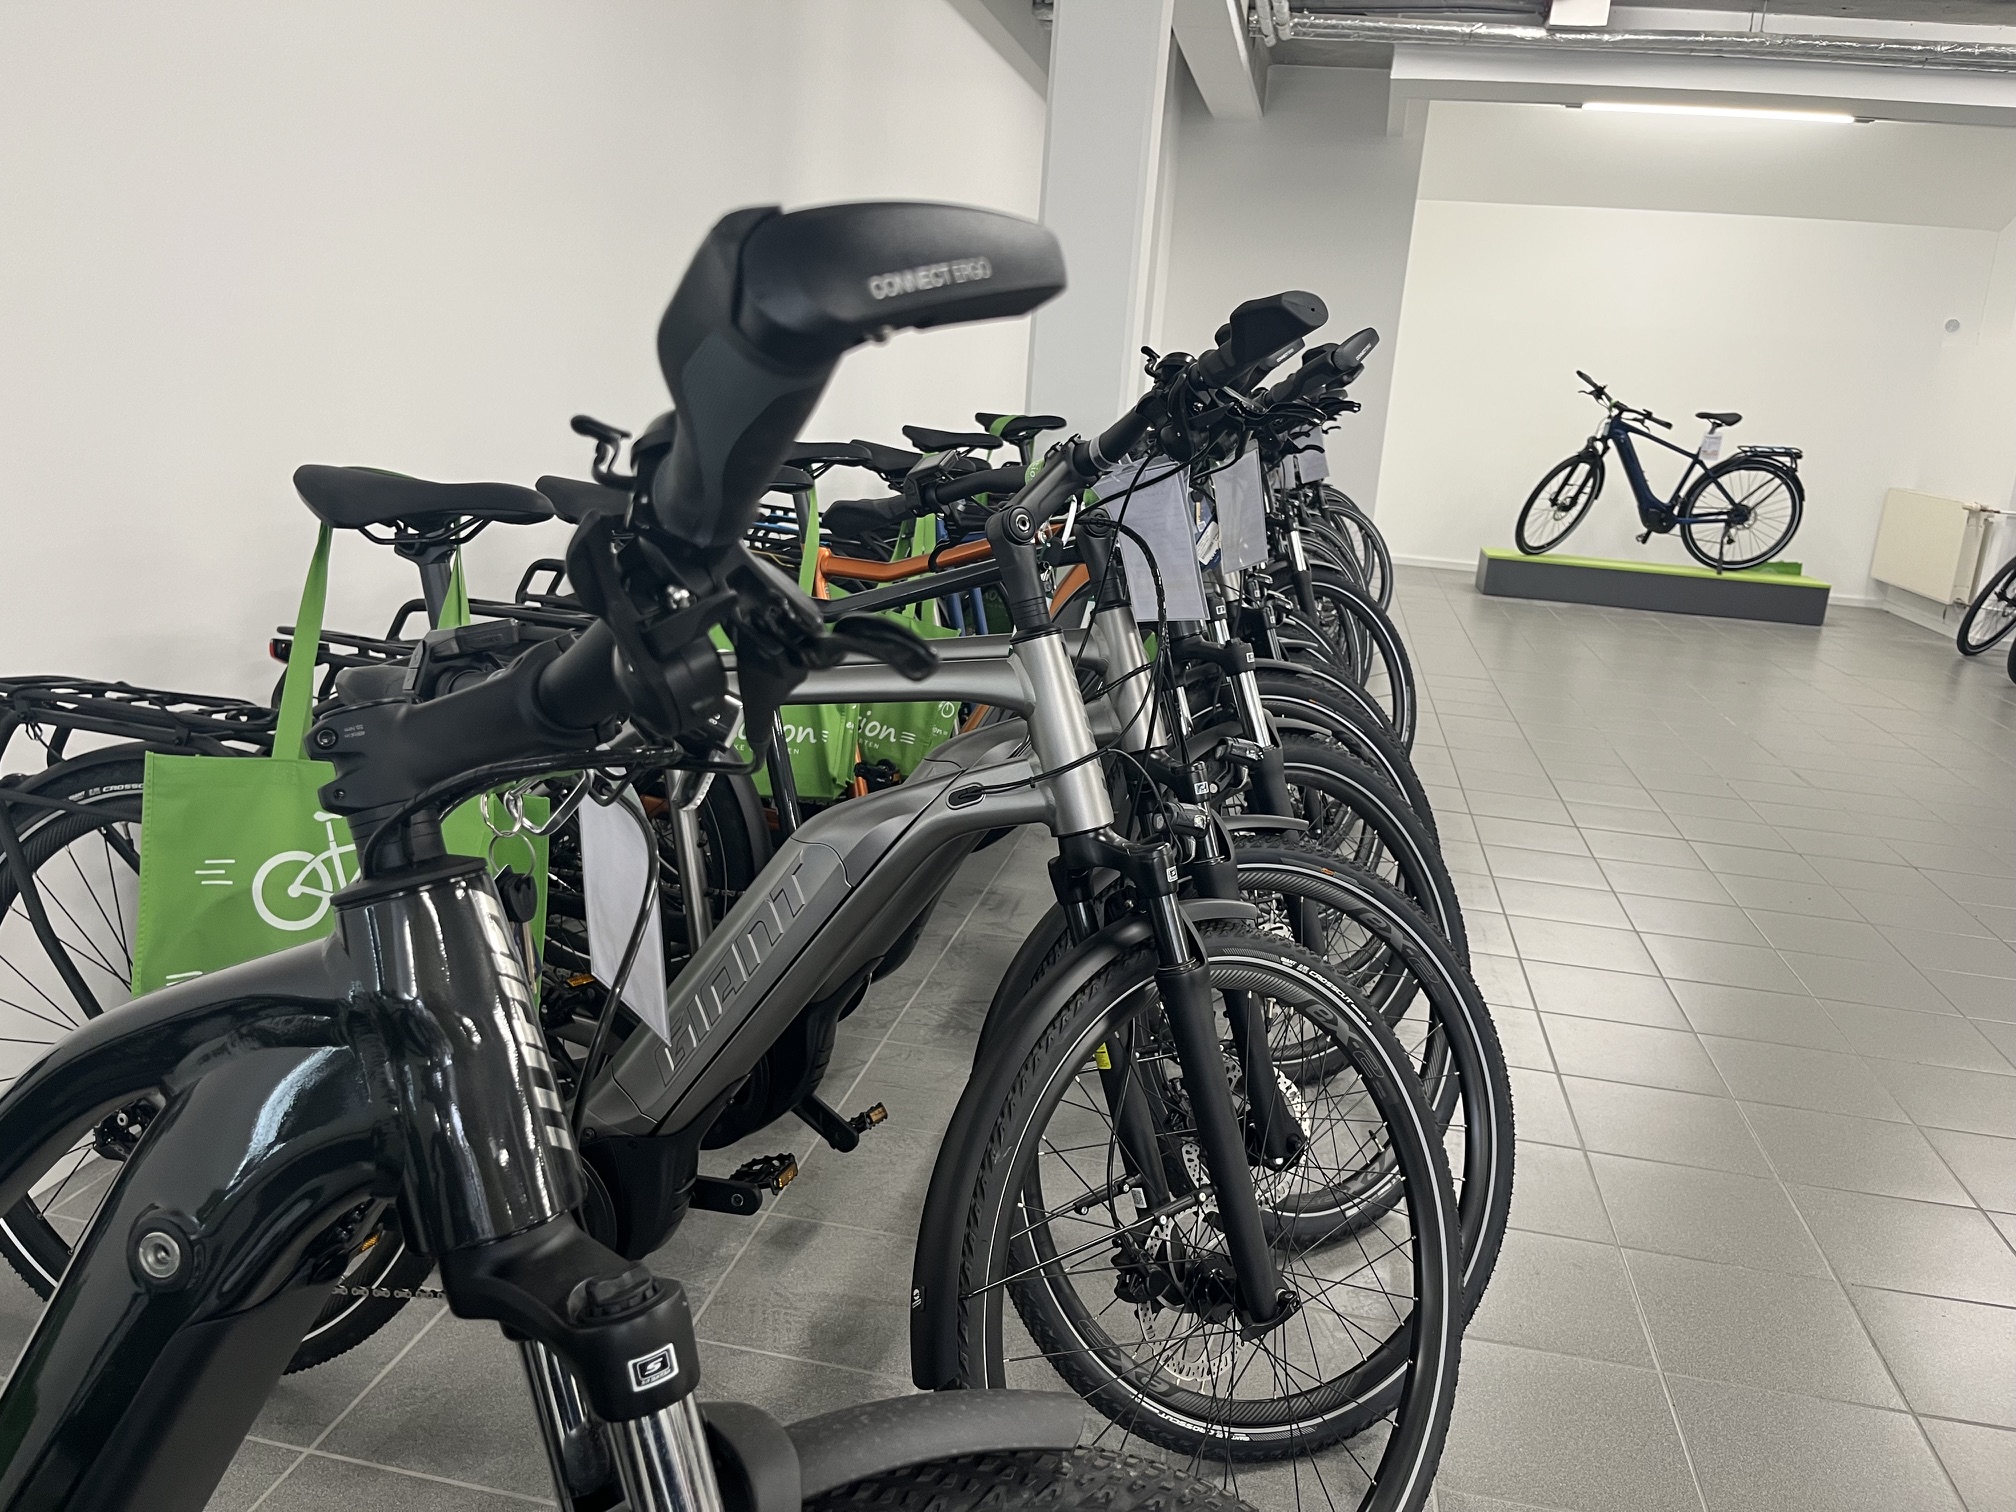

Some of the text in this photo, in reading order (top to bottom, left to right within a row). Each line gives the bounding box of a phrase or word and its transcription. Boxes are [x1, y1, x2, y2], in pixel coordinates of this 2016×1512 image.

[870, 257, 992, 300] CONNECT ERGO
[859, 710, 897, 742] ion
[1308, 970, 1354, 1005] CROSSCUT
